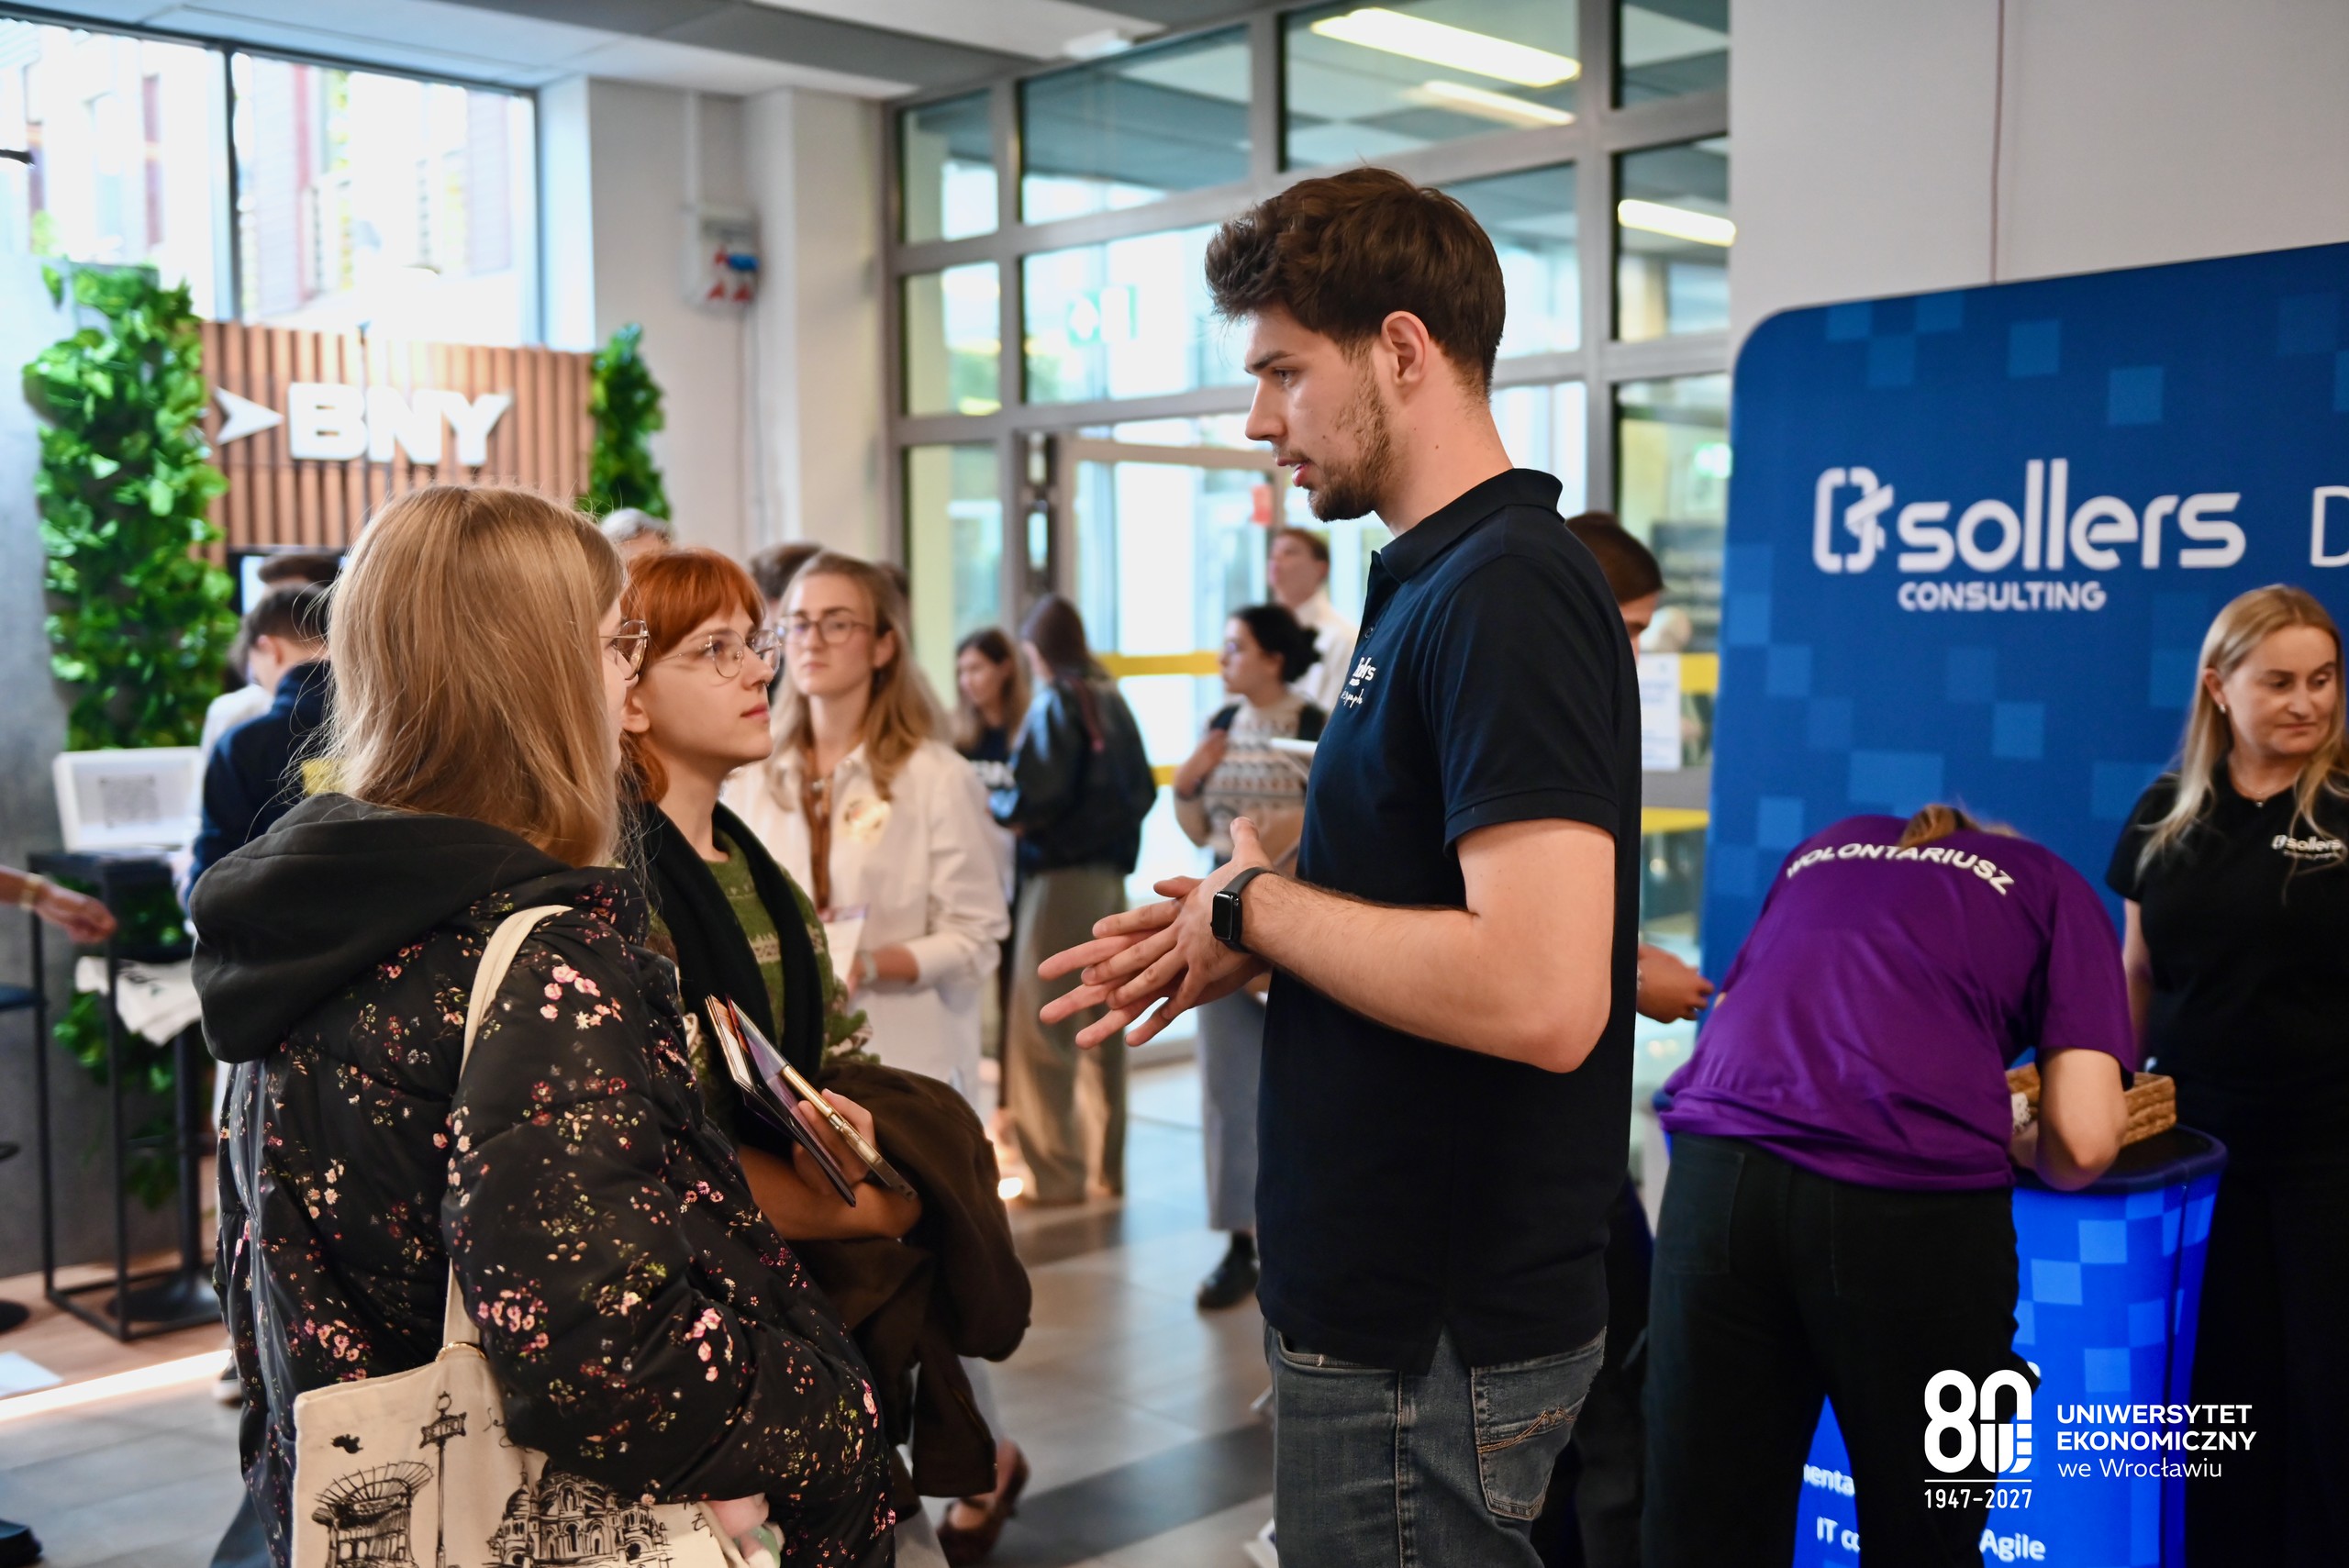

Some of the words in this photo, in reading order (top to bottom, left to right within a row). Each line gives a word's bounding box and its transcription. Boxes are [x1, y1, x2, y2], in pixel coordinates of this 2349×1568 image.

[288, 382, 513, 466] BNY
[1898, 458, 2246, 573] sollers
[1898, 581, 2107, 611] CONSULTING
[1787, 842, 2015, 895] WOLONTARIUSZ
[1817, 1516, 1838, 1544] IT
[1978, 1528, 2046, 1562] Agile
